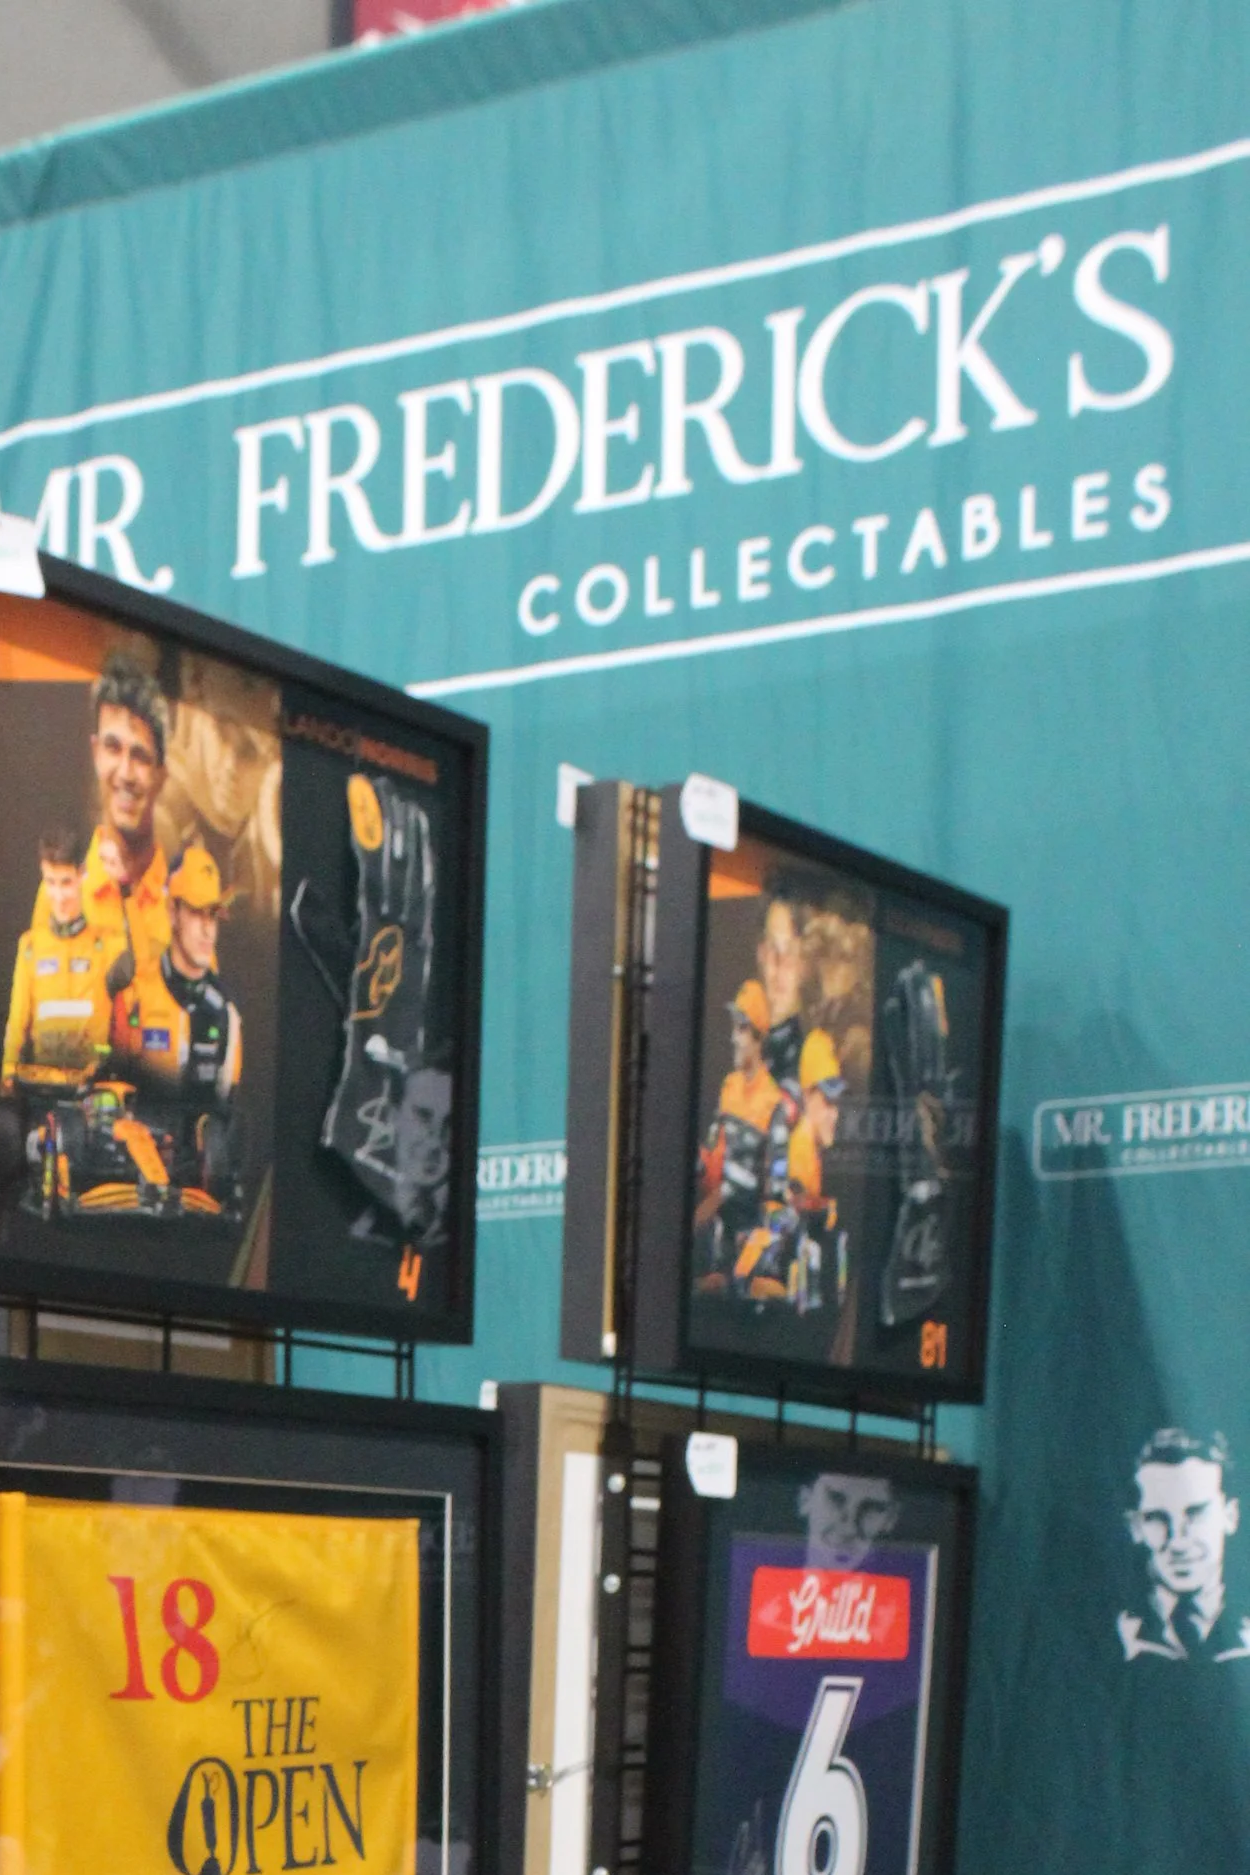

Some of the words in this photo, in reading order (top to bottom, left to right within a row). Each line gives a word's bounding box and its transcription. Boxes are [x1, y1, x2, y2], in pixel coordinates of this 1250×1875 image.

[232, 222, 1175, 579] FREDERICK'S
[517, 463, 1172, 637] COLLECTABLES
[106, 1574, 220, 1703] 18
[231, 1695, 321, 1760] THE
